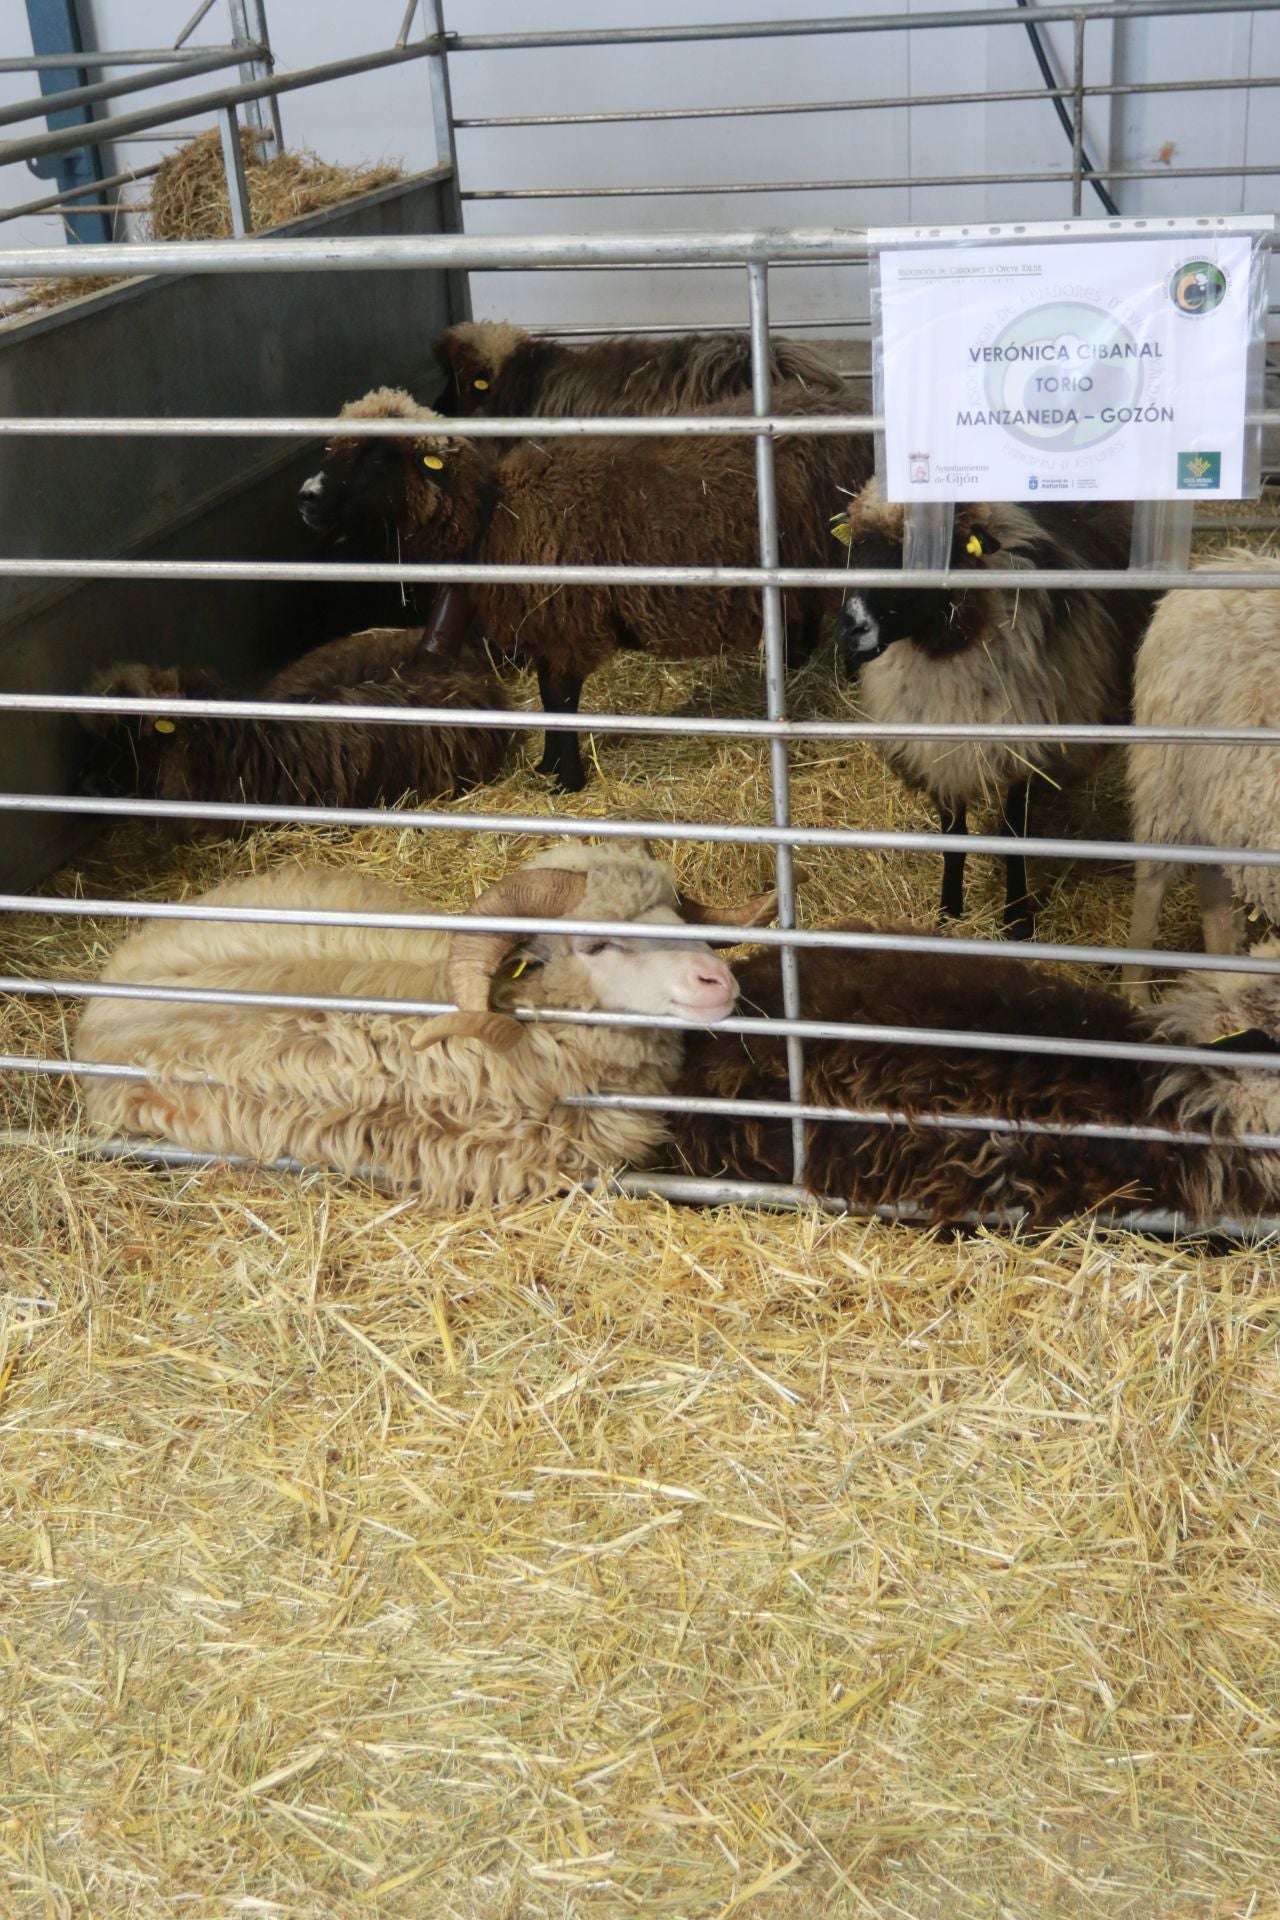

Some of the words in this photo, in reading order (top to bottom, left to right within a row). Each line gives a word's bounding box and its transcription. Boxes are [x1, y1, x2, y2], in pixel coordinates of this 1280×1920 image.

[968, 341, 1070, 363] VERÓNICA
[1076, 341, 1163, 360] CIBANAL
[1035, 376, 1094, 393] TORIO
[956, 409, 1079, 426] MANZANEDA
[1100, 403, 1175, 424] GOZÓN
[946, 472, 979, 487] Gijón
